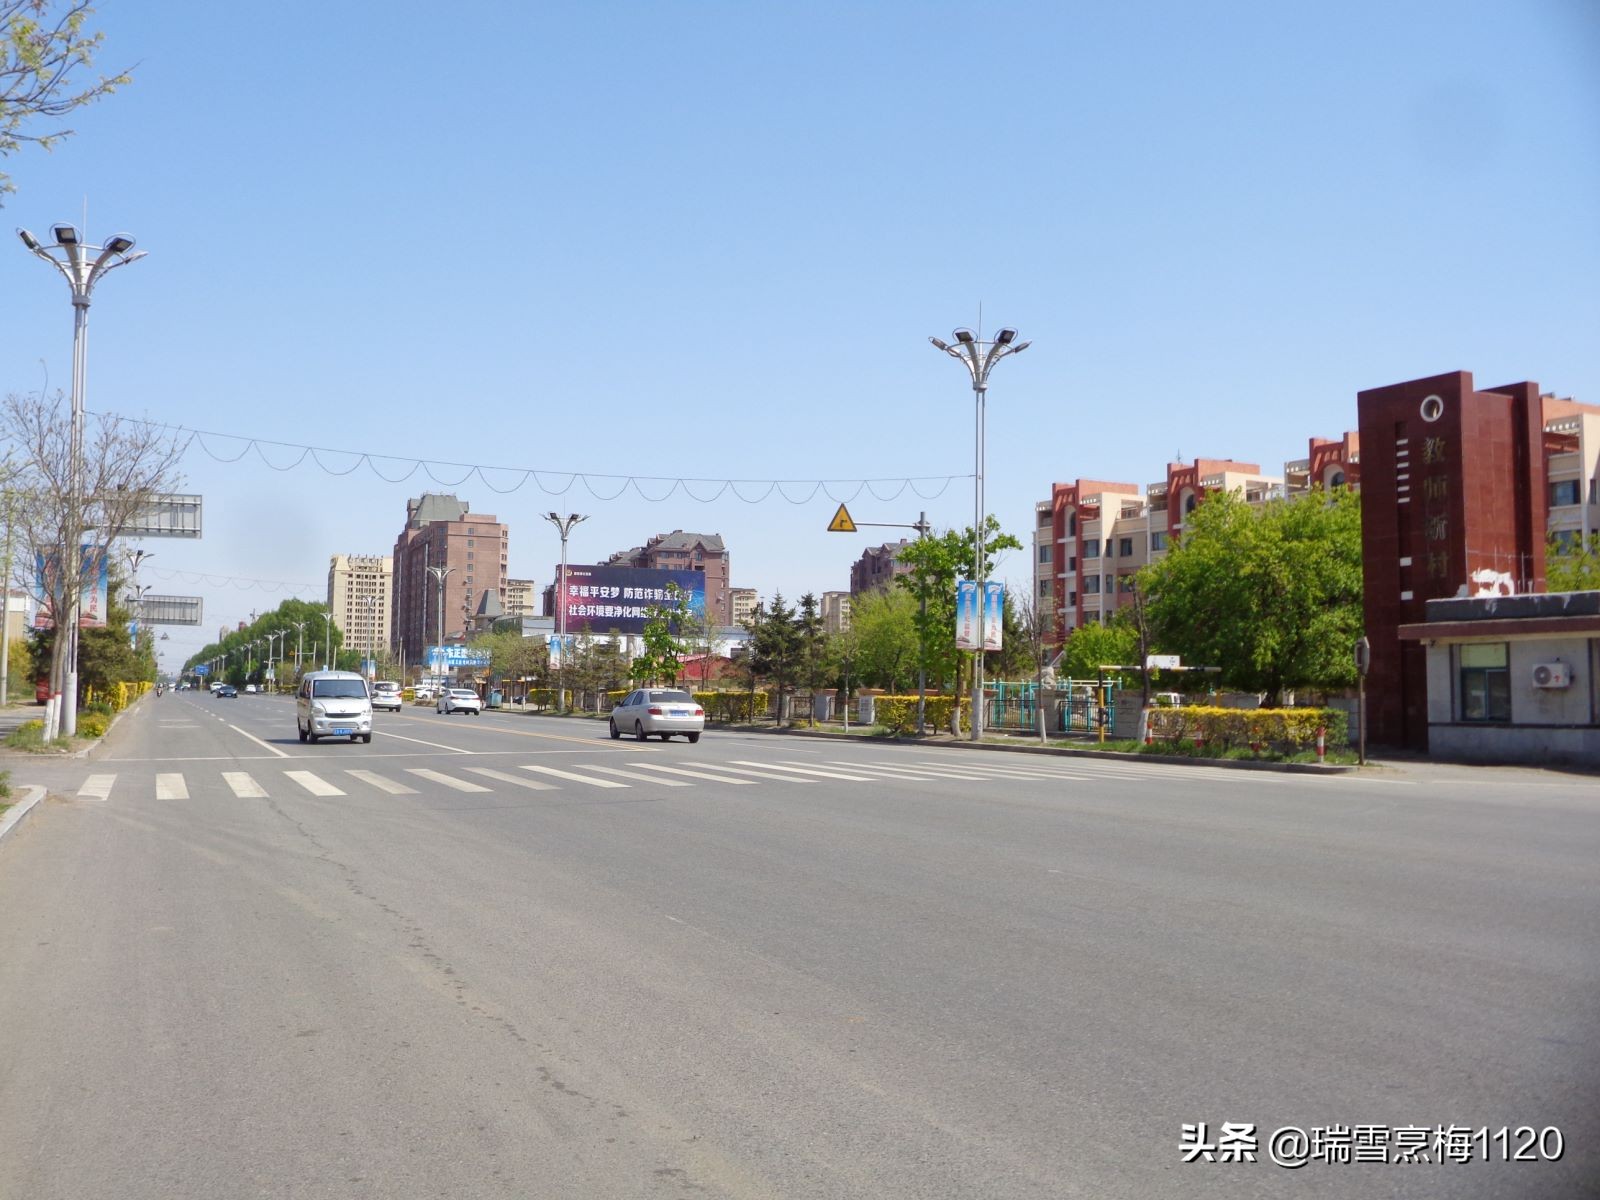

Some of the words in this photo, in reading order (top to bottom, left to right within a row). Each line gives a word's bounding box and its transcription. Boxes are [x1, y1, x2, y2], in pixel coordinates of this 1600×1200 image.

[569, 585, 620, 599] 幸福平安梦
